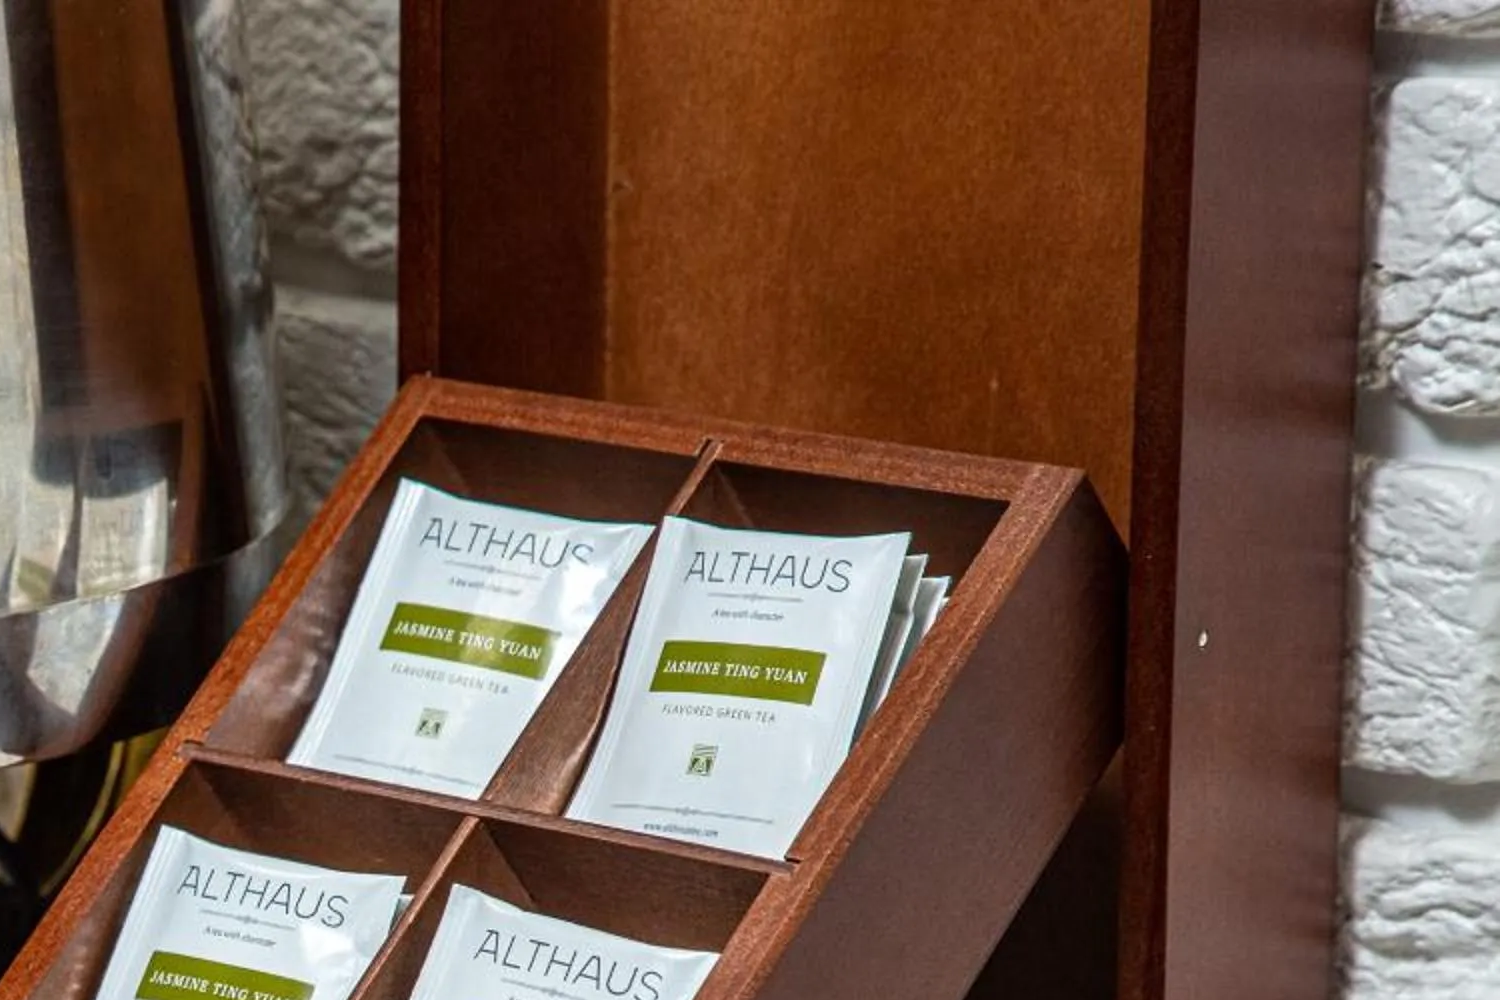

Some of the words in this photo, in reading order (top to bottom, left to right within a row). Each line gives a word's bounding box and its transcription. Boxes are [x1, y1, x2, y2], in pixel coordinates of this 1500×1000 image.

[419, 516, 594, 569] ALTHAUS
[684, 551, 853, 593] ALTHAUS
[393, 620, 455, 643] JASMINE
[458, 631, 495, 650] TING
[499, 639, 542, 661] YUAN
[390, 662, 446, 683] FLAVORED
[447, 671, 485, 690] GREEN
[488, 682, 510, 695] TEA
[662, 659, 721, 676] JASMINE
[724, 663, 760, 680] TING
[764, 667, 808, 684] YUAN
[661, 703, 714, 717] FLAVORED
[716, 707, 751, 721] GREEN
[755, 710, 776, 724] TEA
[177, 865, 350, 929] ALTHAUS
[149, 969, 211, 993] JASMINE
[212, 981, 249, 1000] TING
